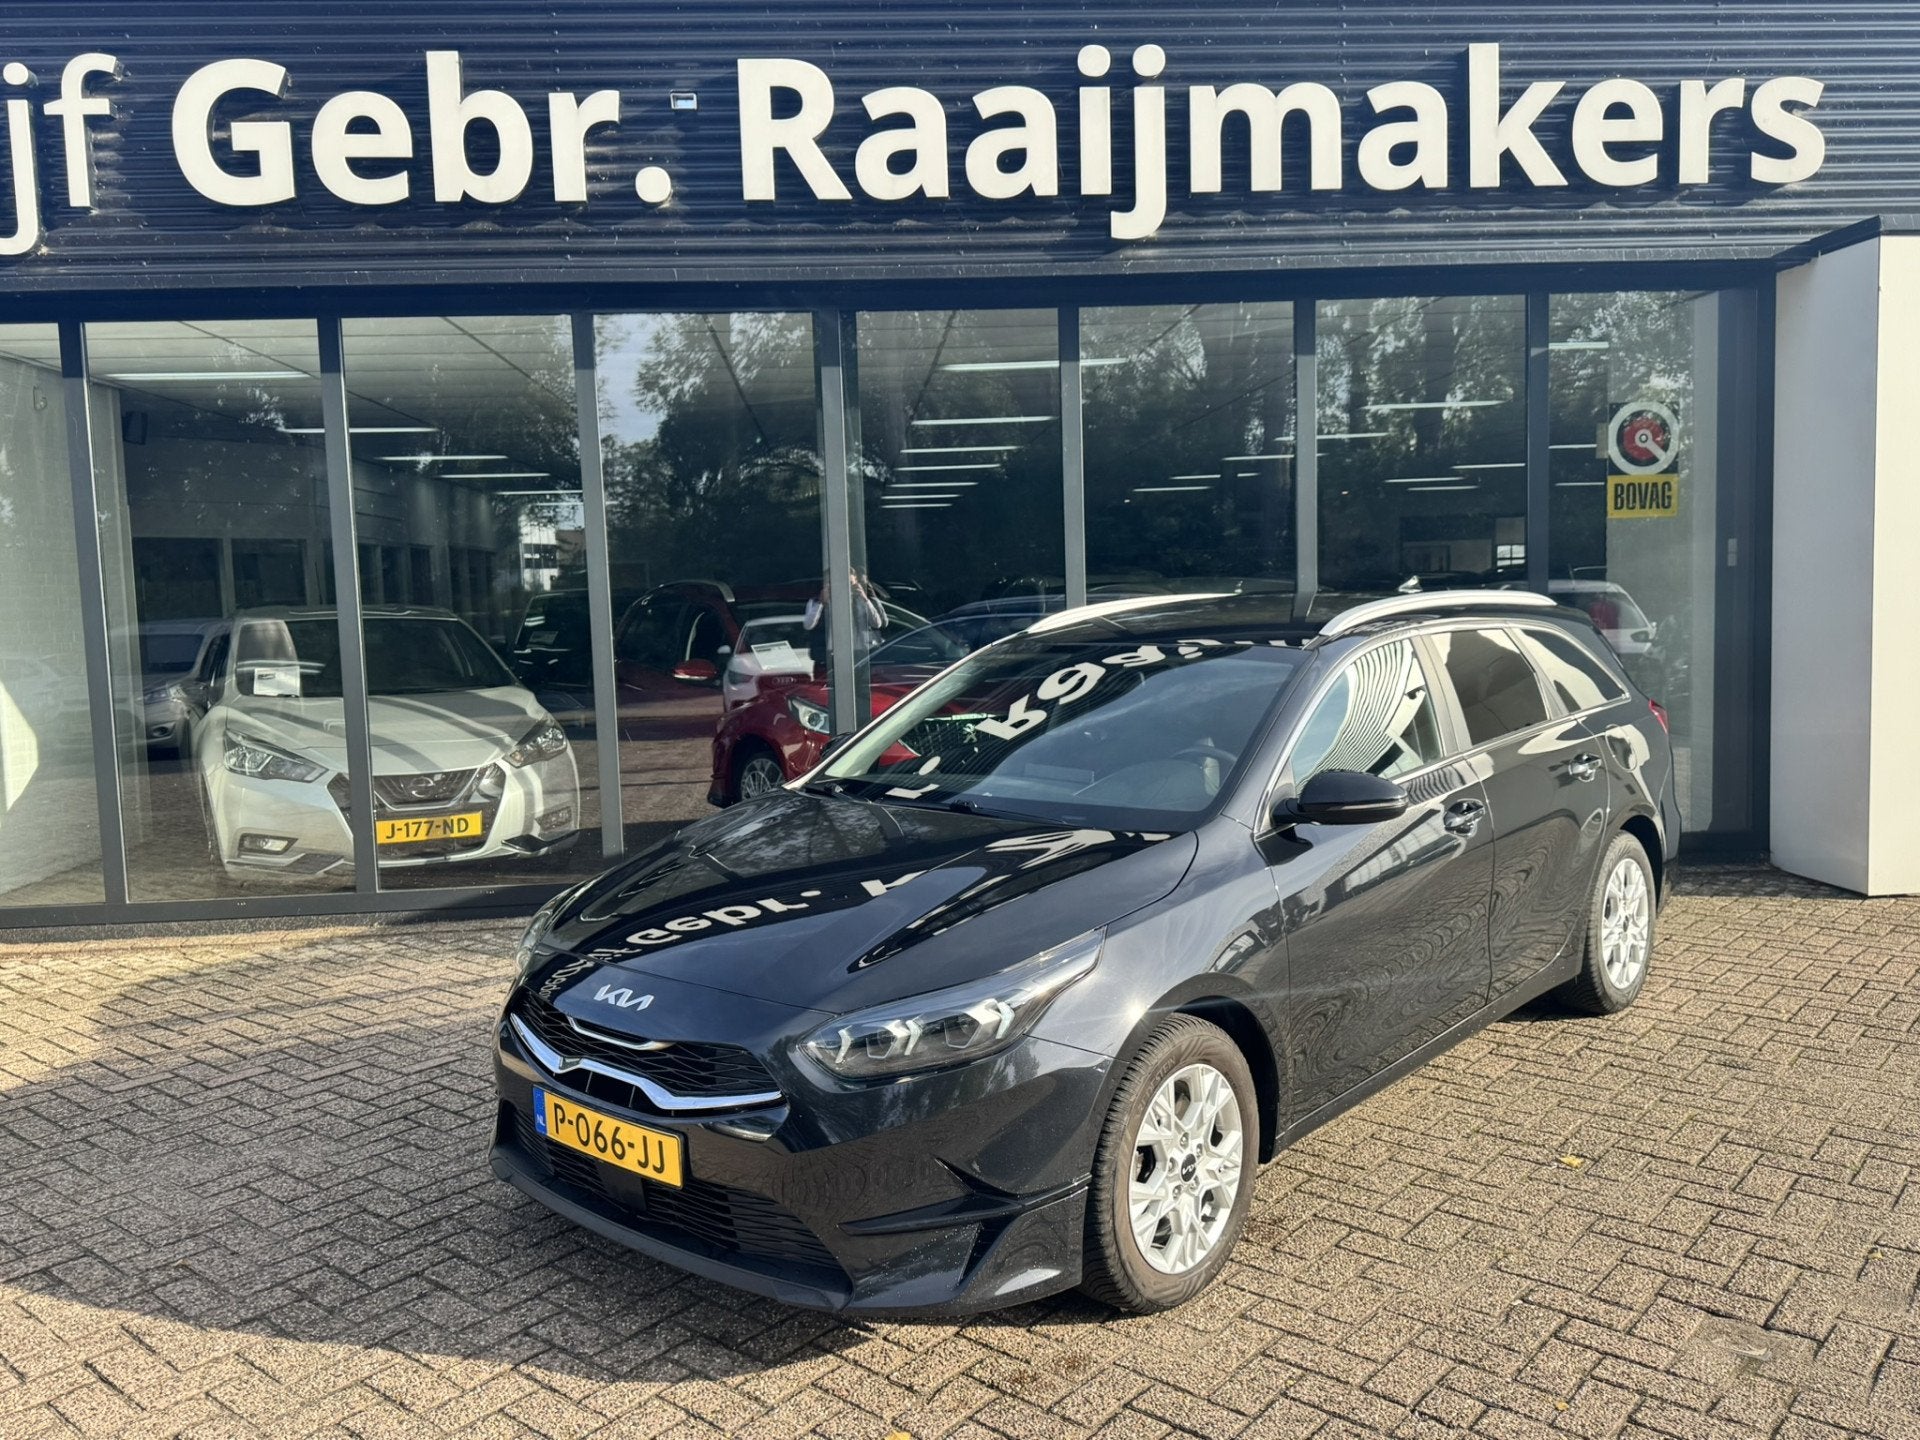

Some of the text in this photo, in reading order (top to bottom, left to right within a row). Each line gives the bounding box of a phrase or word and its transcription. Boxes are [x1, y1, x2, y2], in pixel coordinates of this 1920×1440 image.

[172, 50, 673, 207] Gebr.
[736, 42, 1826, 240] Raaijmakers
[1613, 481, 1672, 511] BOVAG
[385, 817, 469, 839] J-177-ND
[593, 984, 654, 1011] KIA
[553, 1102, 666, 1174] P-066-JJ
